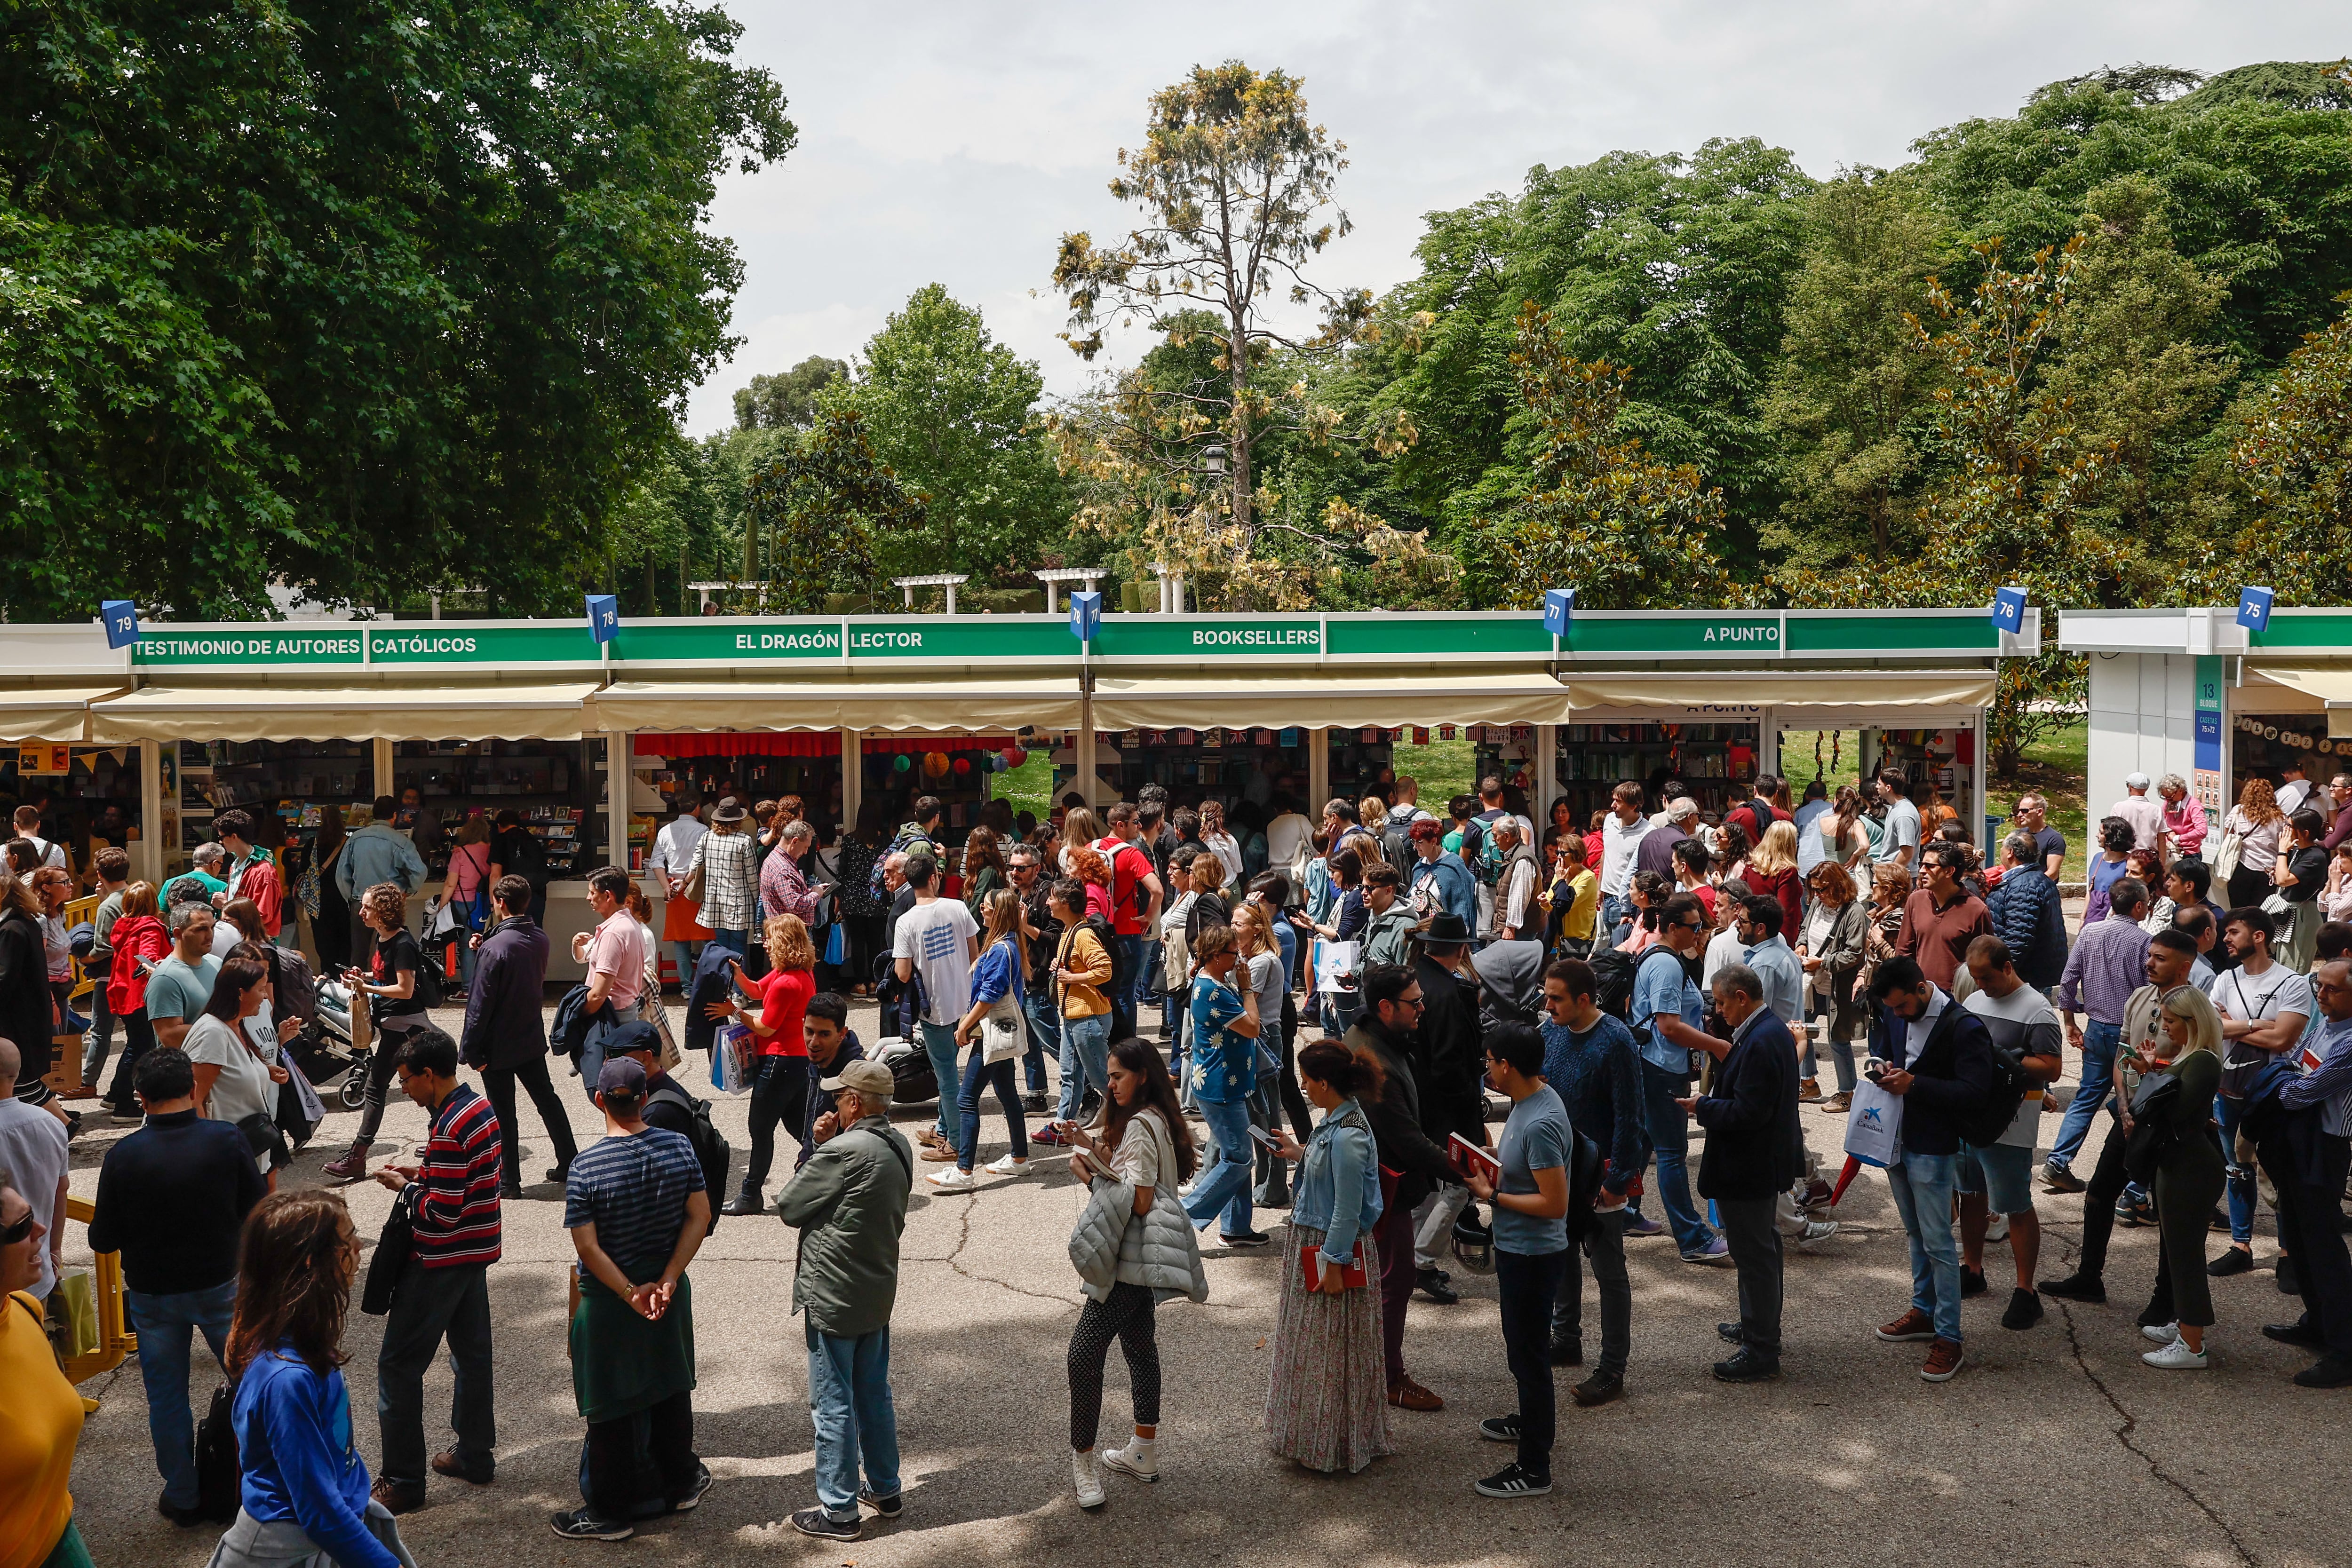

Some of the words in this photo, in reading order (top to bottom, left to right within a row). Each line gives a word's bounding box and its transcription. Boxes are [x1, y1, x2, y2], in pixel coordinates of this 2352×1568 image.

[1073, 607, 1081, 625] 78
[1090, 607, 1098, 625] 77
[1549, 603, 1560, 620] 77
[2001, 602, 2015, 618] 76
[2246, 602, 2260, 618] 75
[116, 617, 132, 634] 79
[602, 610, 613, 628] 78
[736, 635, 756, 649] EL
[761, 630, 838, 649] DRAGÓN
[850, 633, 922, 648] LECTOR
[1193, 630, 1319, 645] BOOKSELLERS
[1704, 628, 1716, 641] A
[1720, 627, 1778, 641] PUNTO
[135, 640, 244, 656] TESTIMONIO
[249, 641, 271, 654] DE
[276, 640, 360, 654] AUTORES
[372, 635, 476, 654] CATÓLICOS
[2203, 683, 2215, 698] 13
[2200, 699, 2217, 708] BLOQUE
[1857, 1120, 1884, 1134] CaixaBank
